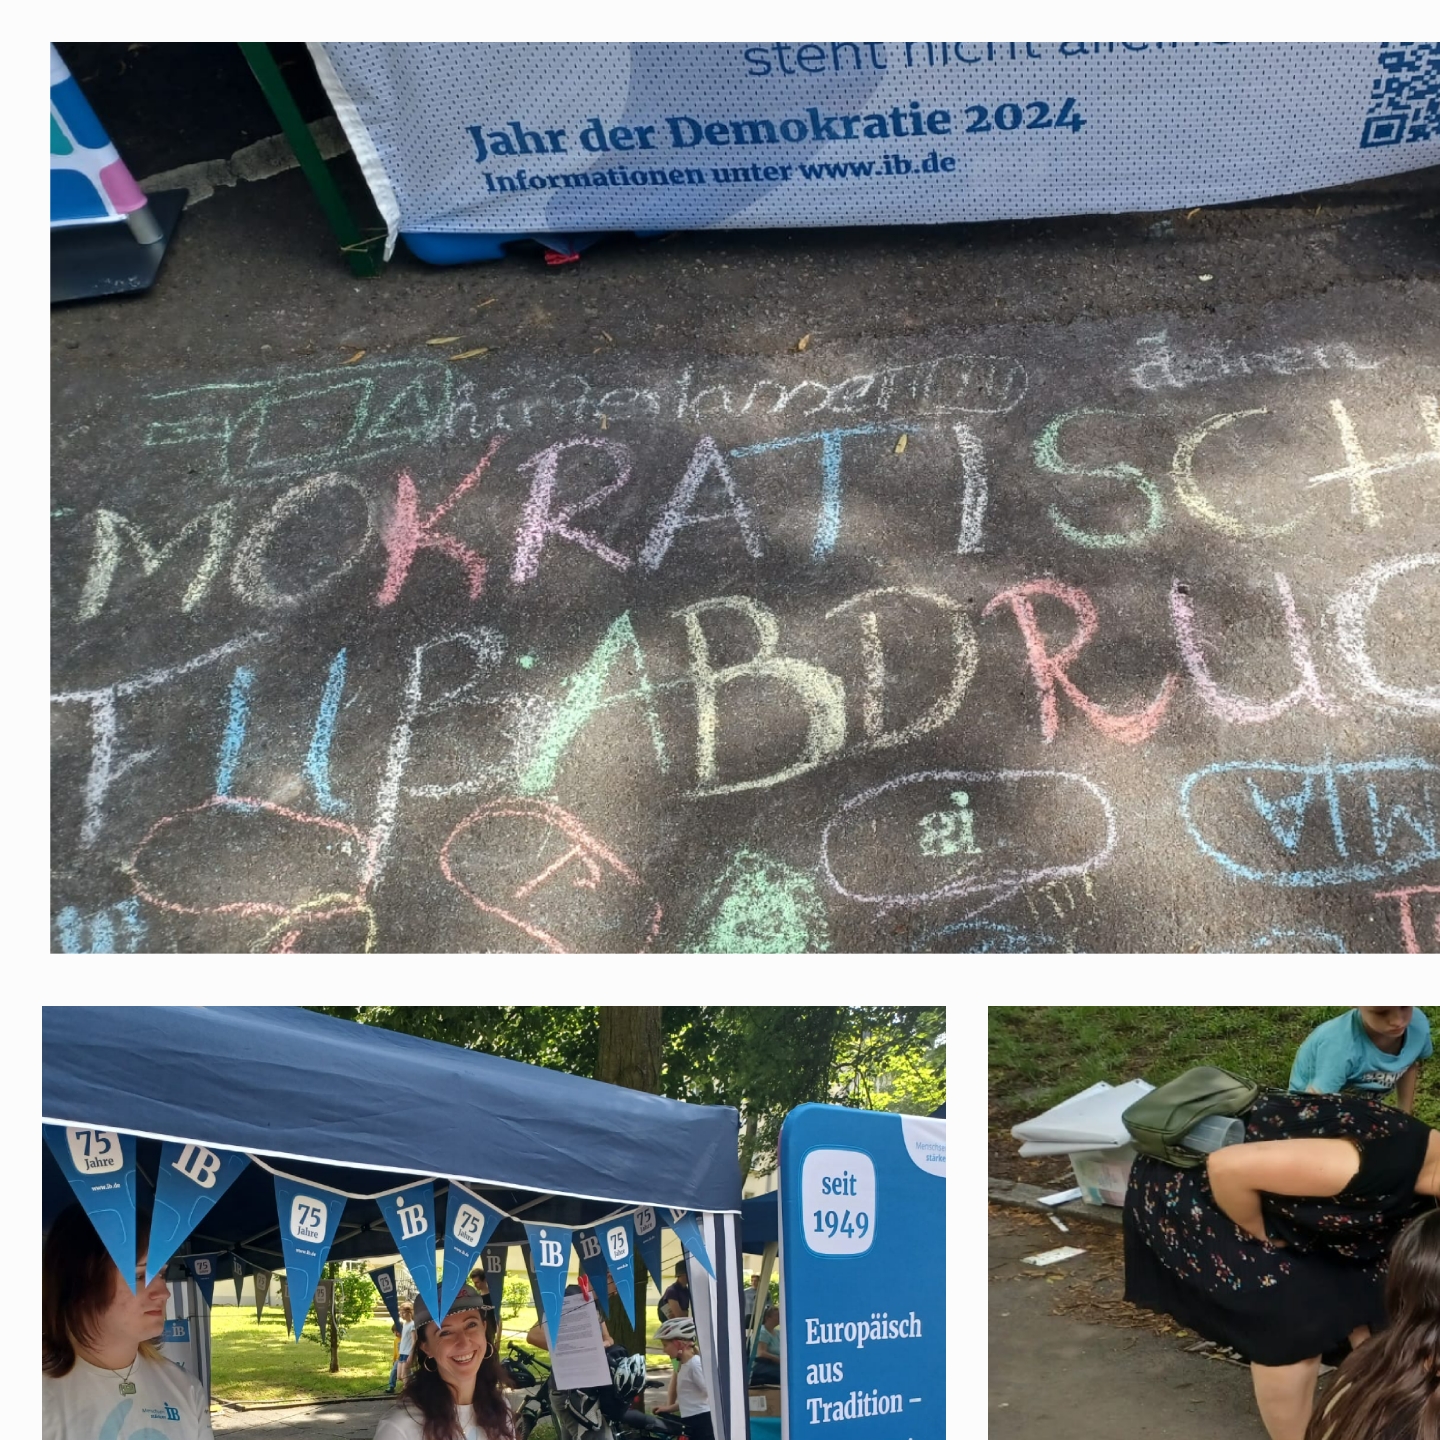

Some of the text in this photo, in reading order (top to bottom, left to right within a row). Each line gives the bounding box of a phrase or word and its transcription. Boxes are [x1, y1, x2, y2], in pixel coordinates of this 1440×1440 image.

[467, 96, 1087, 163] Jahr der Demokratie 2024
[485, 149, 957, 194] Informationen unter www.ib.de
[75, 1130, 111, 1156] 75
[84, 1155, 115, 1171] Jahre
[821, 1169, 859, 1196] seit
[297, 1203, 322, 1228] 75
[460, 1210, 482, 1231] 75
[636, 1208, 652, 1225] 75
[813, 1209, 870, 1239] 1949
[296, 1228, 320, 1240] Jahre
[457, 1228, 476, 1243] Jahre
[610, 1232, 626, 1250] 75
[805, 1311, 923, 1348] Europäisch
[806, 1359, 844, 1386] aus
[806, 1389, 904, 1425] Tradition
